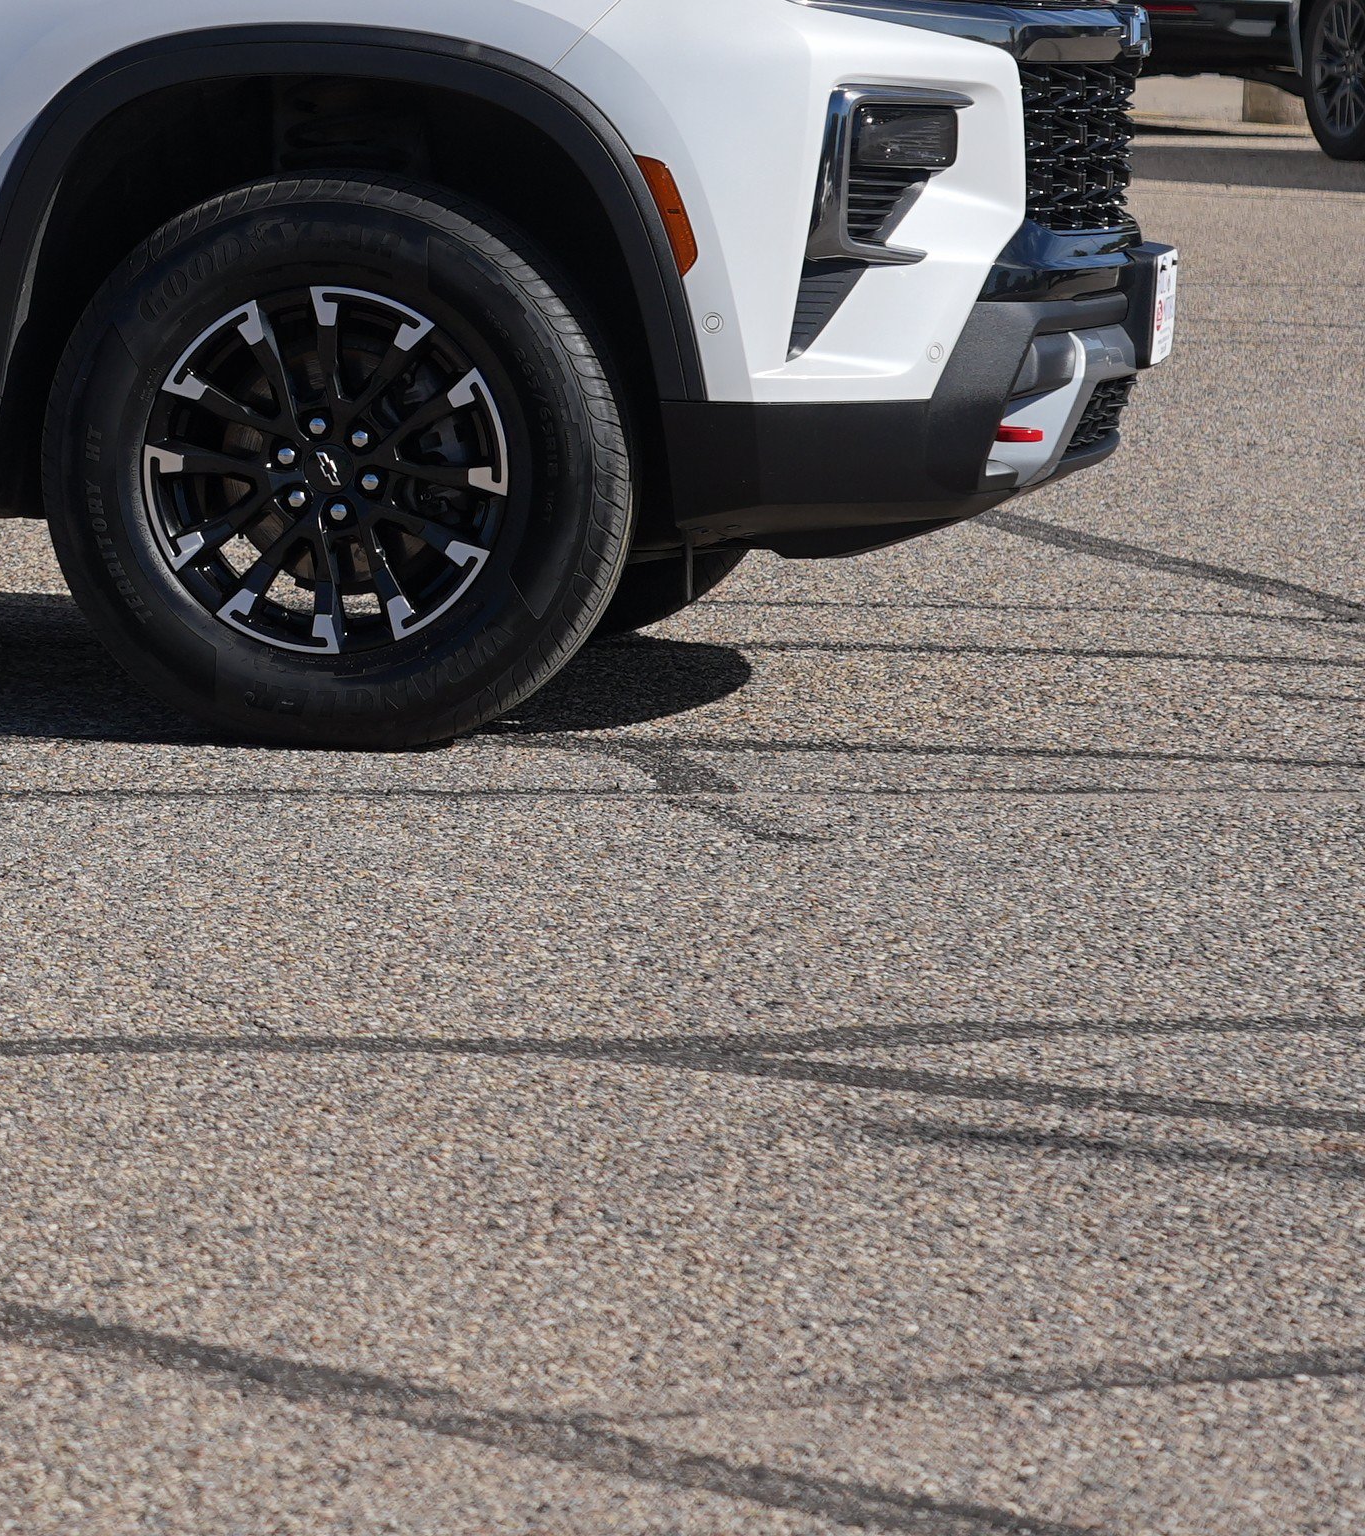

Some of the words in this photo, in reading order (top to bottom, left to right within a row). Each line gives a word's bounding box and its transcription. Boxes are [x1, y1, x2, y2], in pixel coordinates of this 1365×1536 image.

[138, 217, 403, 324] GOODYEAR
[84, 423, 103, 463] HT
[85, 478, 154, 625] TERRITORY
